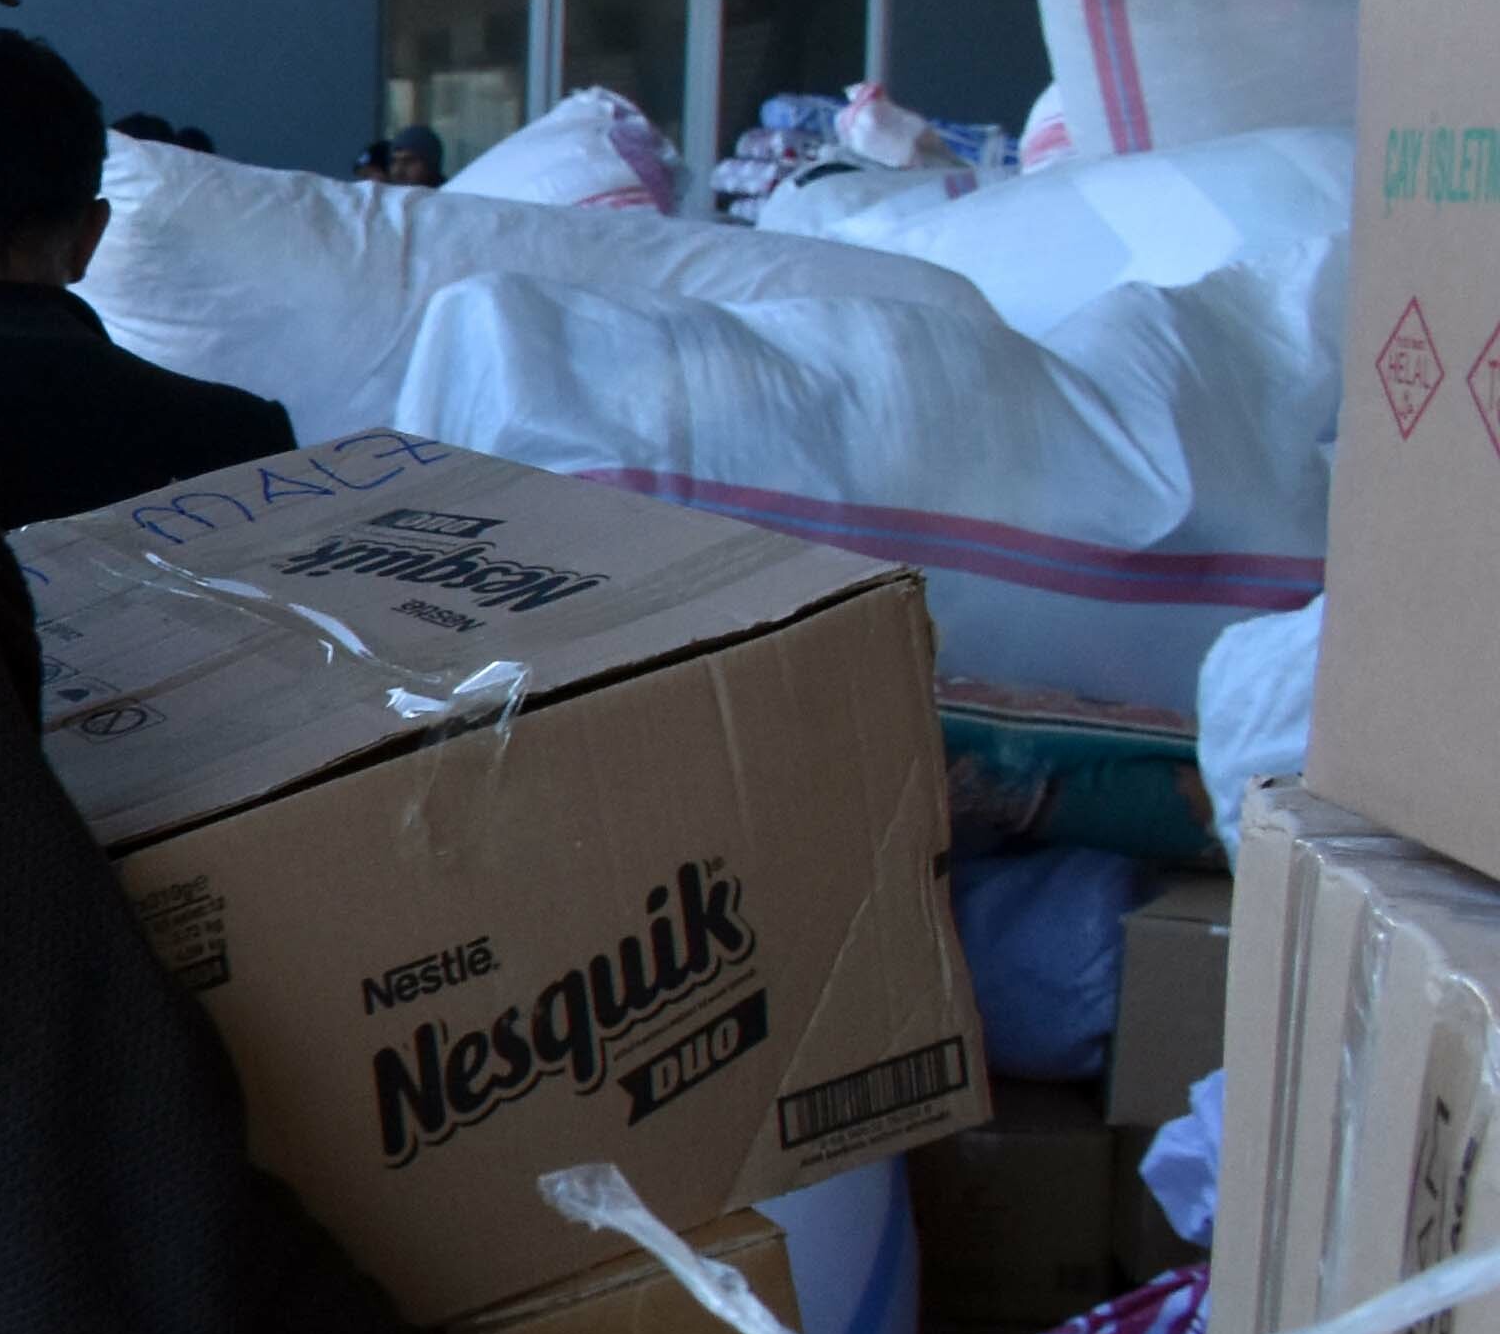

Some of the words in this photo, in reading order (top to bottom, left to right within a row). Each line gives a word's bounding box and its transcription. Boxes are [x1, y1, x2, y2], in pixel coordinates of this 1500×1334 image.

[286, 535, 609, 613] Nesquik
[373, 859, 752, 1165] Nesquik
[650, 1017, 742, 1103] DUO
